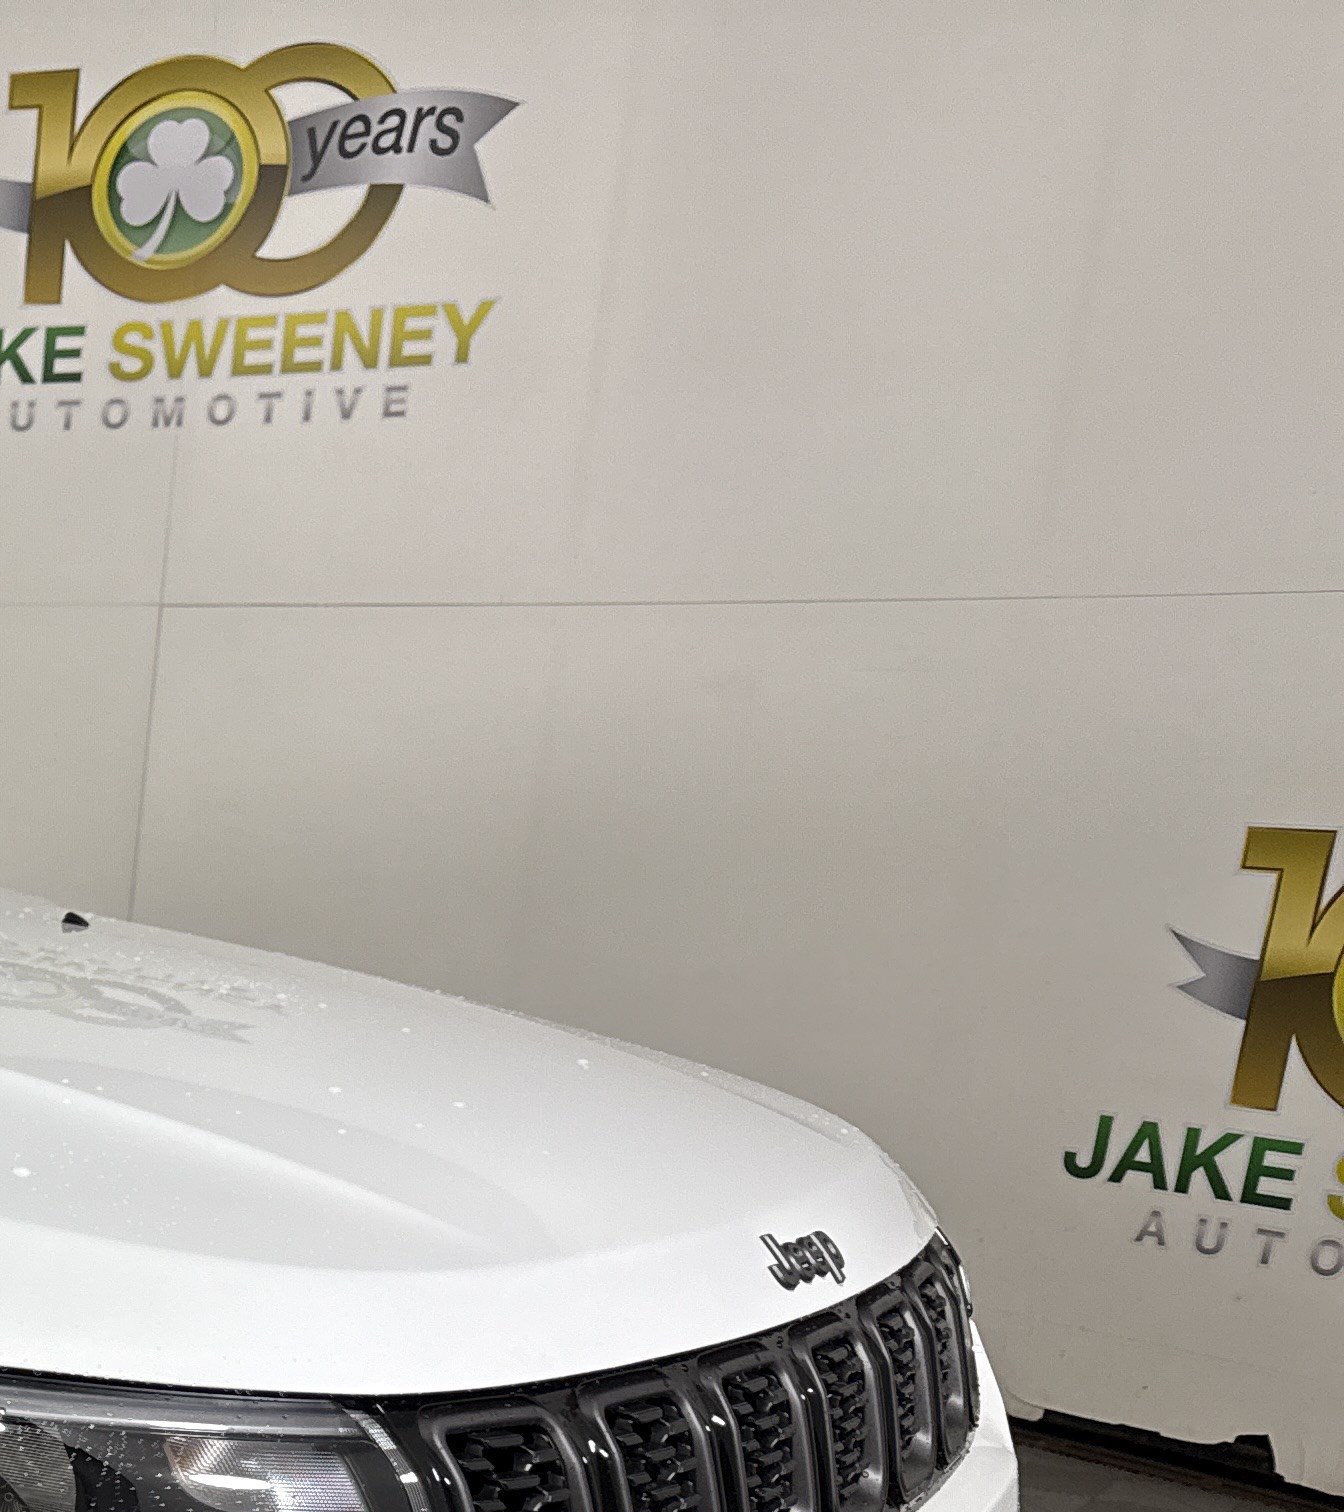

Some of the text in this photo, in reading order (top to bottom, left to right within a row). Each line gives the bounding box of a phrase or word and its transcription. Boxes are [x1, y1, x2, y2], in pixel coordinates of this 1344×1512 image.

[8, 42, 464, 305] 100 years
[108, 298, 498, 382] SWEENEY
[1063, 1114, 1305, 1211] JAKE
[759, 1230, 846, 1291] Jeep
